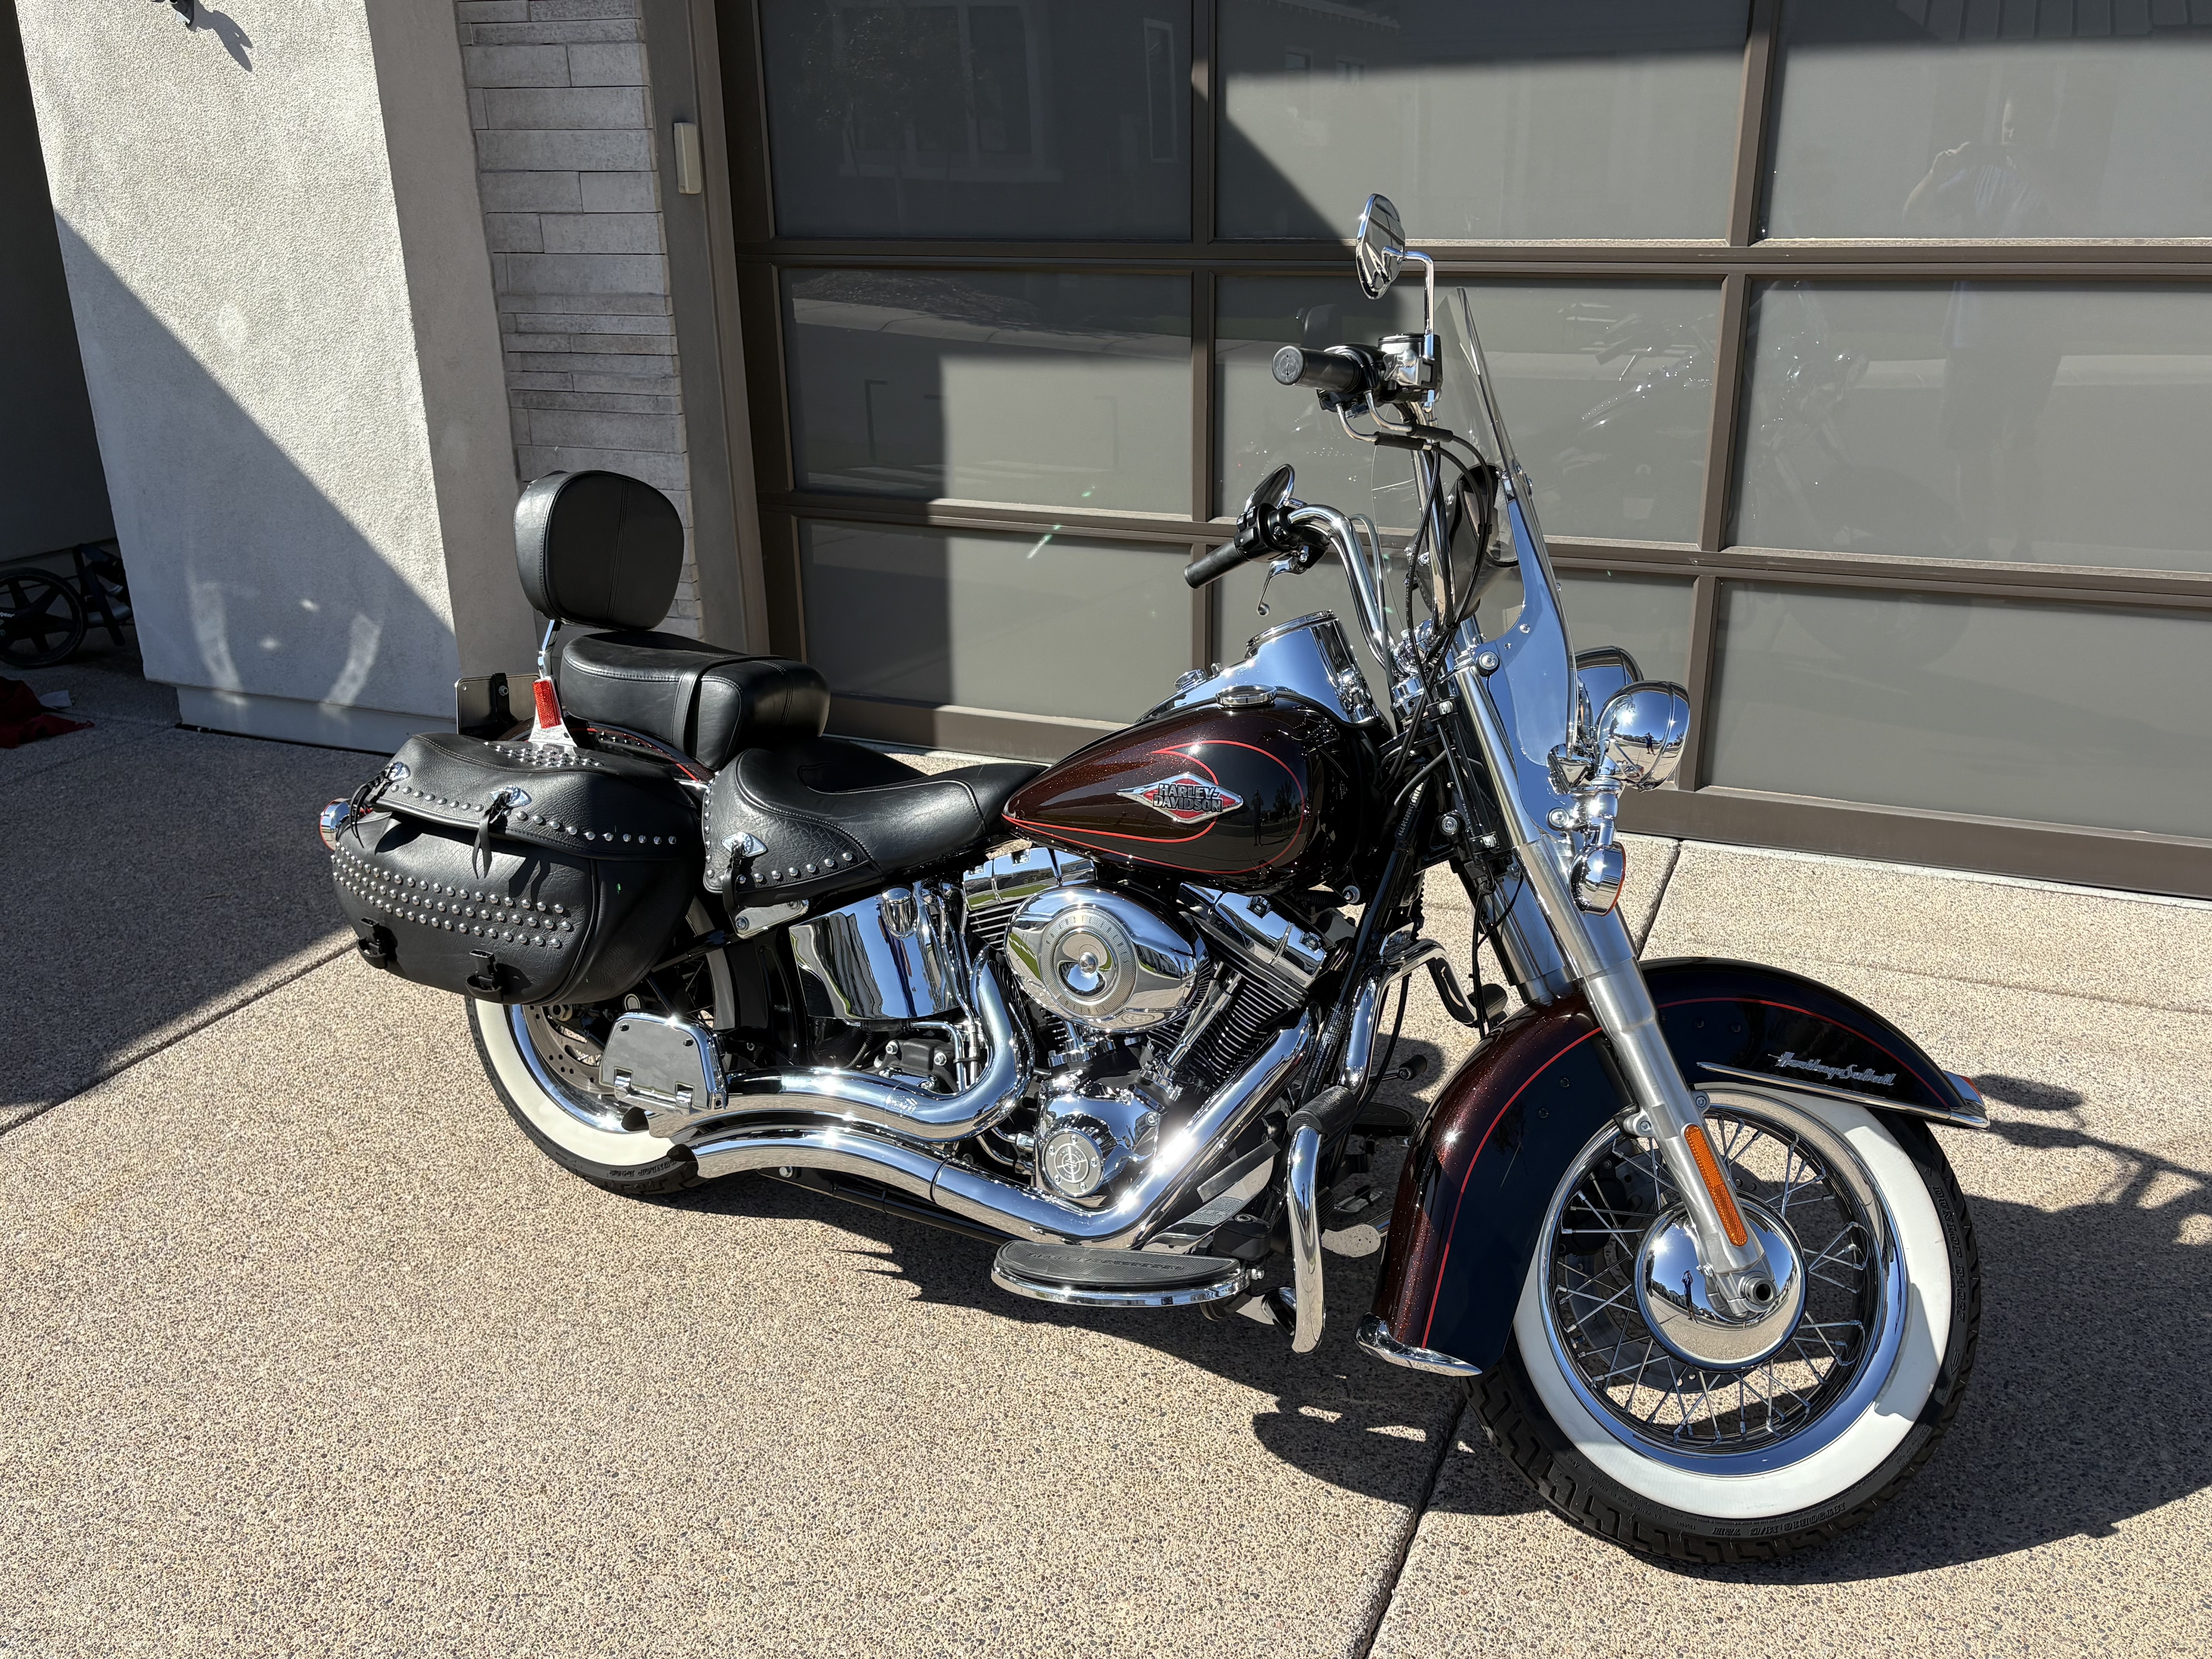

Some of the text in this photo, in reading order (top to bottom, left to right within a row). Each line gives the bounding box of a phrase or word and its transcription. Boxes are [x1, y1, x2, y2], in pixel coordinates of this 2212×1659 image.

[1159, 783, 1220, 799] HARLEY-
[1153, 795, 1223, 812] DAVIDSON
[1932, 1185, 1963, 1258] DUNLOP
